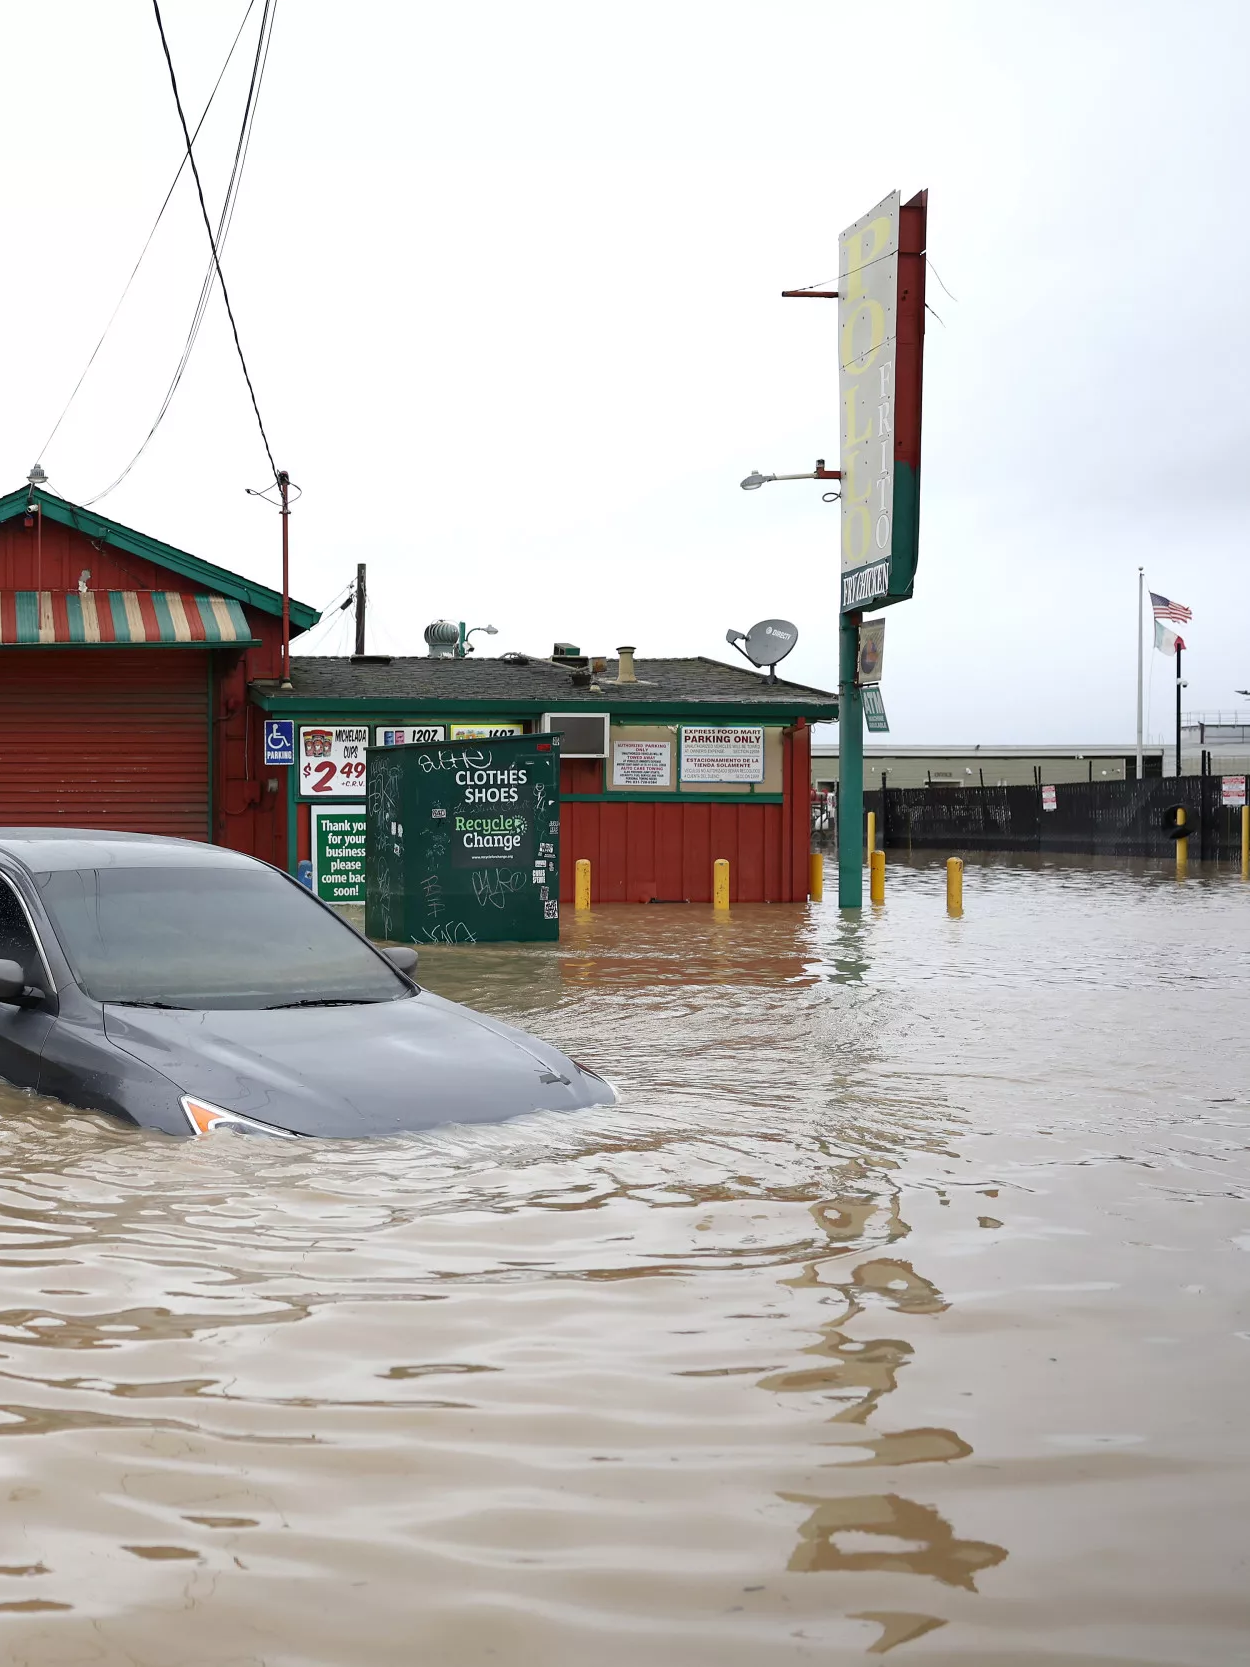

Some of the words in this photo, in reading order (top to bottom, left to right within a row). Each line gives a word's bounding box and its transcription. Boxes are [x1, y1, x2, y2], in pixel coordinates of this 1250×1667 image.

[842, 217, 891, 561] POLLO
[876, 361, 892, 549] FRITO
[857, 562, 890, 600] CHICKEN
[863, 691, 884, 715] ATM
[335, 729, 366, 742] MICHELADA
[684, 735, 731, 743] PARKING
[734, 735, 761, 743] ONLY
[267, 750, 292, 760] PARKING
[344, 746, 358, 759] CUPS
[455, 770, 528, 785] CLOTHES
[465, 788, 519, 803] SHOES
[321, 820, 350, 831] Thank
[455, 815, 513, 834] Recycle
[328, 833, 342, 844] for
[344, 835, 366, 847] your
[463, 832, 521, 851] Change
[331, 859, 361, 873] please
[321, 874, 347, 883] come
[349, 872, 366, 883] bac
[334, 885, 359, 896] soon!
